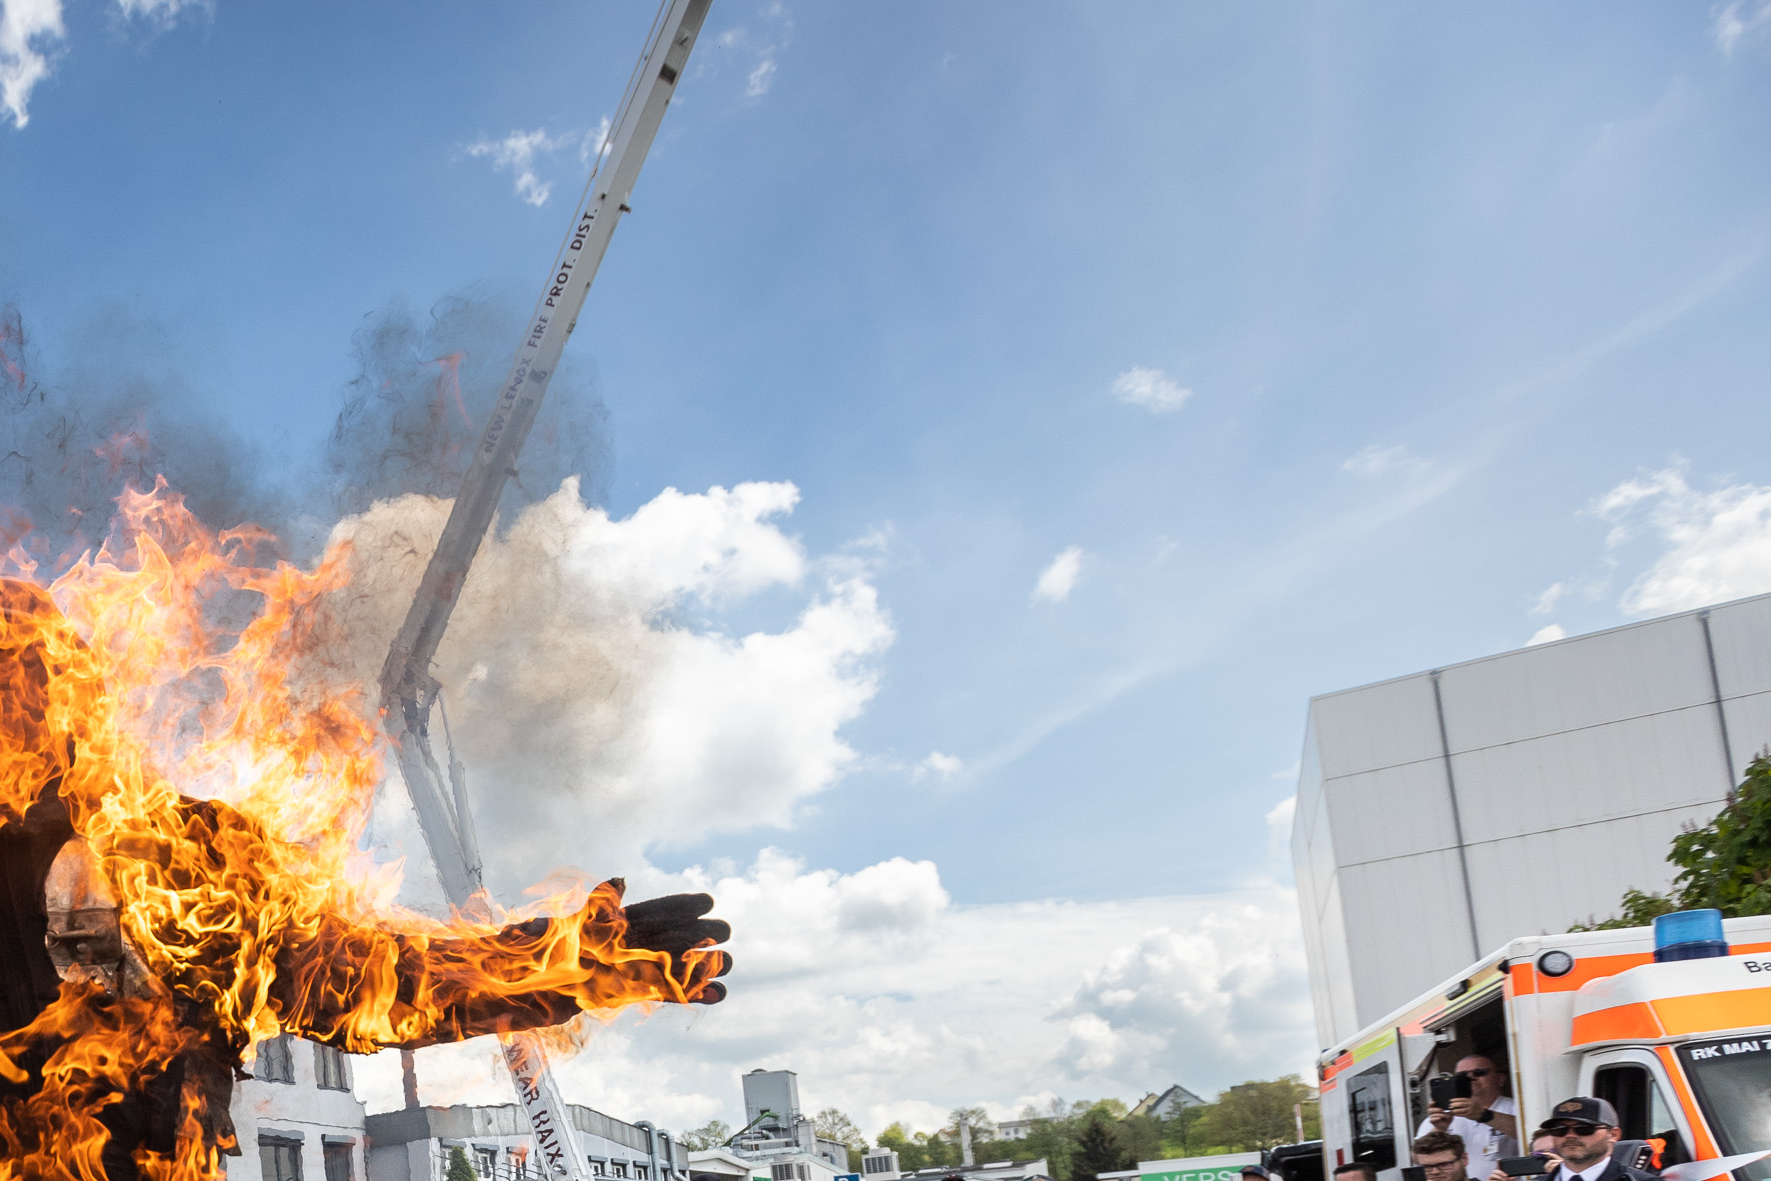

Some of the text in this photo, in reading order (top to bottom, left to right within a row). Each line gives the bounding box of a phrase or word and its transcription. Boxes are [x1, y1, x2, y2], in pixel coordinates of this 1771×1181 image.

[483, 413, 506, 453] NEW
[527, 316, 549, 348] FIRE
[545, 258, 576, 307] PROT.
[570, 208, 599, 251] DIST.
[1690, 1045, 1721, 1061] RK
[1722, 1040, 1760, 1055] MAI
